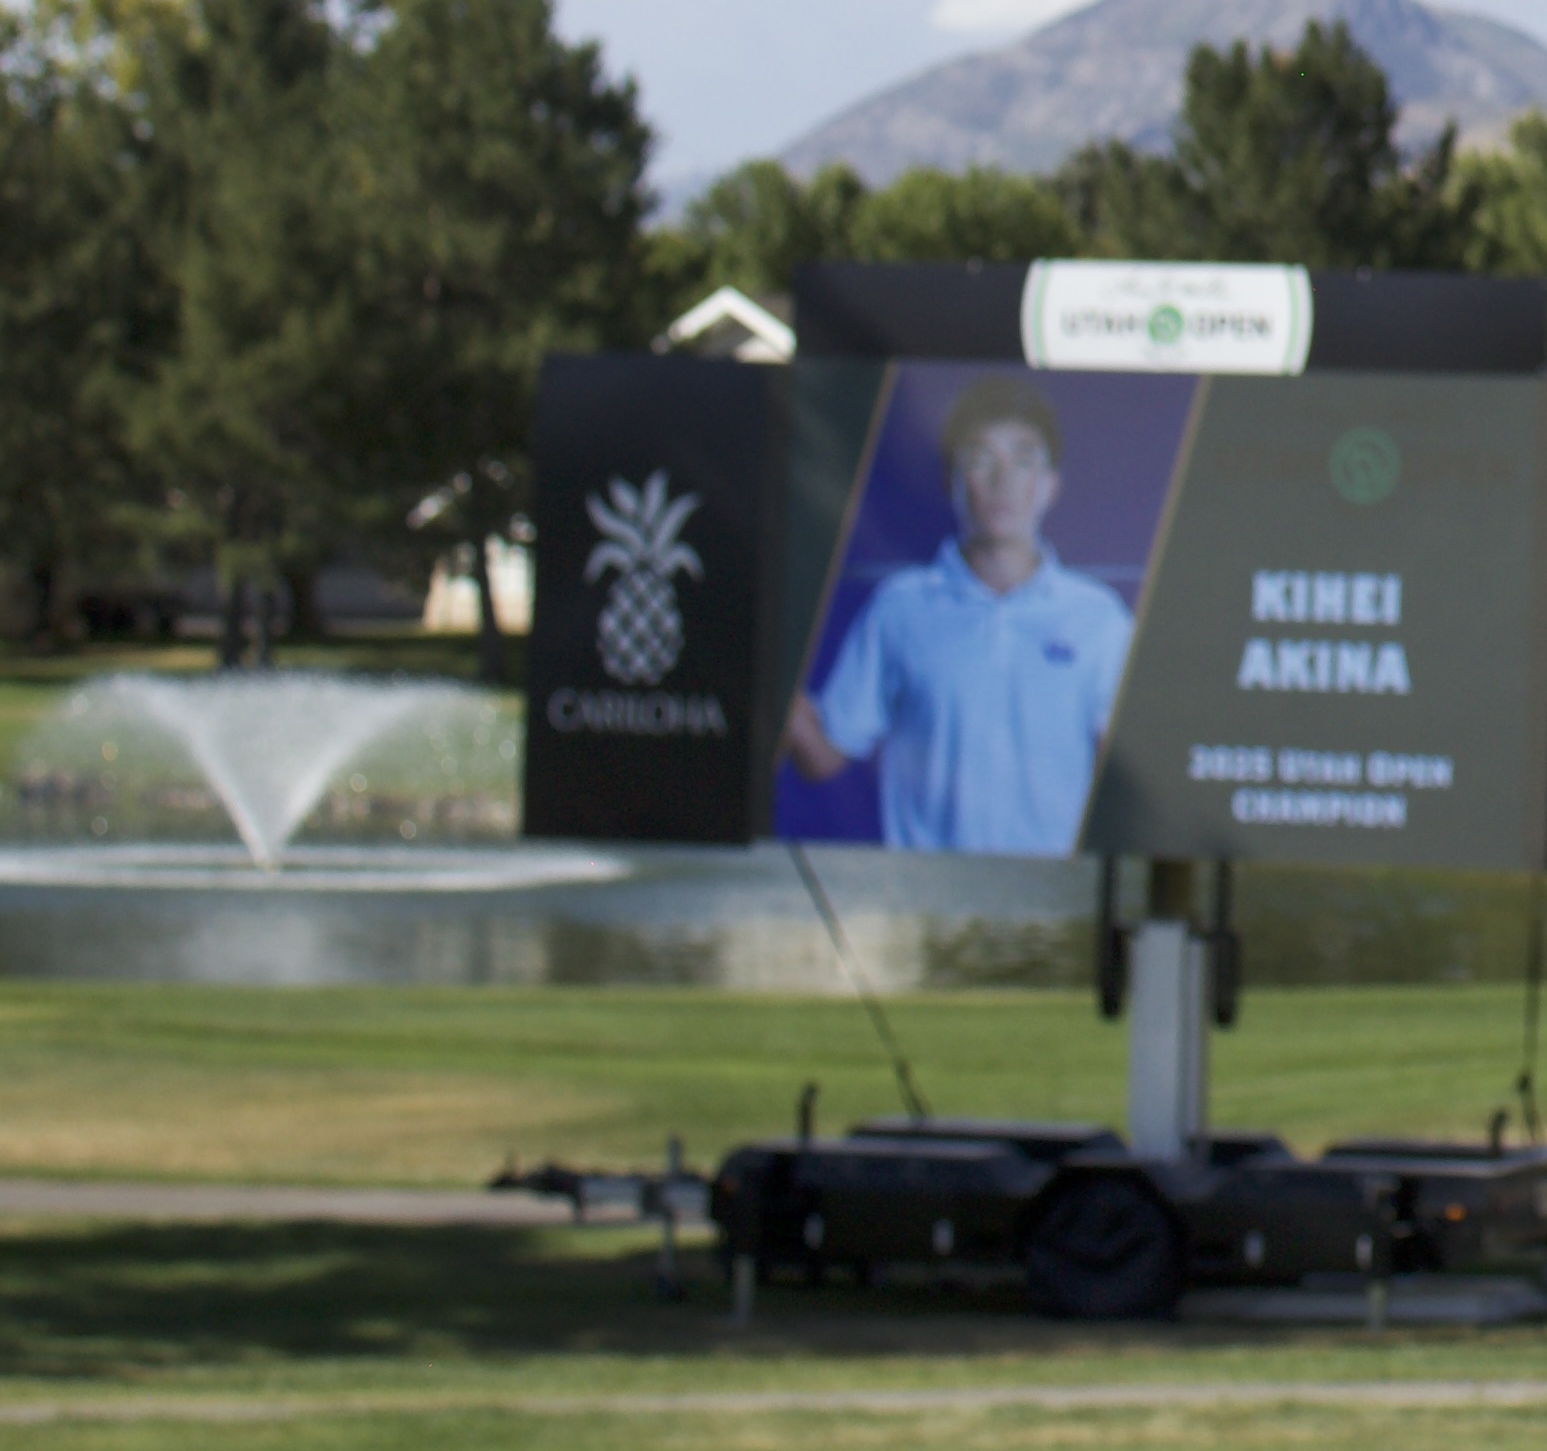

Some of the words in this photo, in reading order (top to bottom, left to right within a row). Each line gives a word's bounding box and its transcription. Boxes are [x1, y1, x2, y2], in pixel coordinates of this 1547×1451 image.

[1190, 310, 1273, 343] OPEN
[1250, 568, 1403, 626] KIHEI
[1236, 637, 1413, 695] AKINA
[546, 687, 728, 737] CARILOHA
[1231, 786, 1409, 829] CHAMPION
